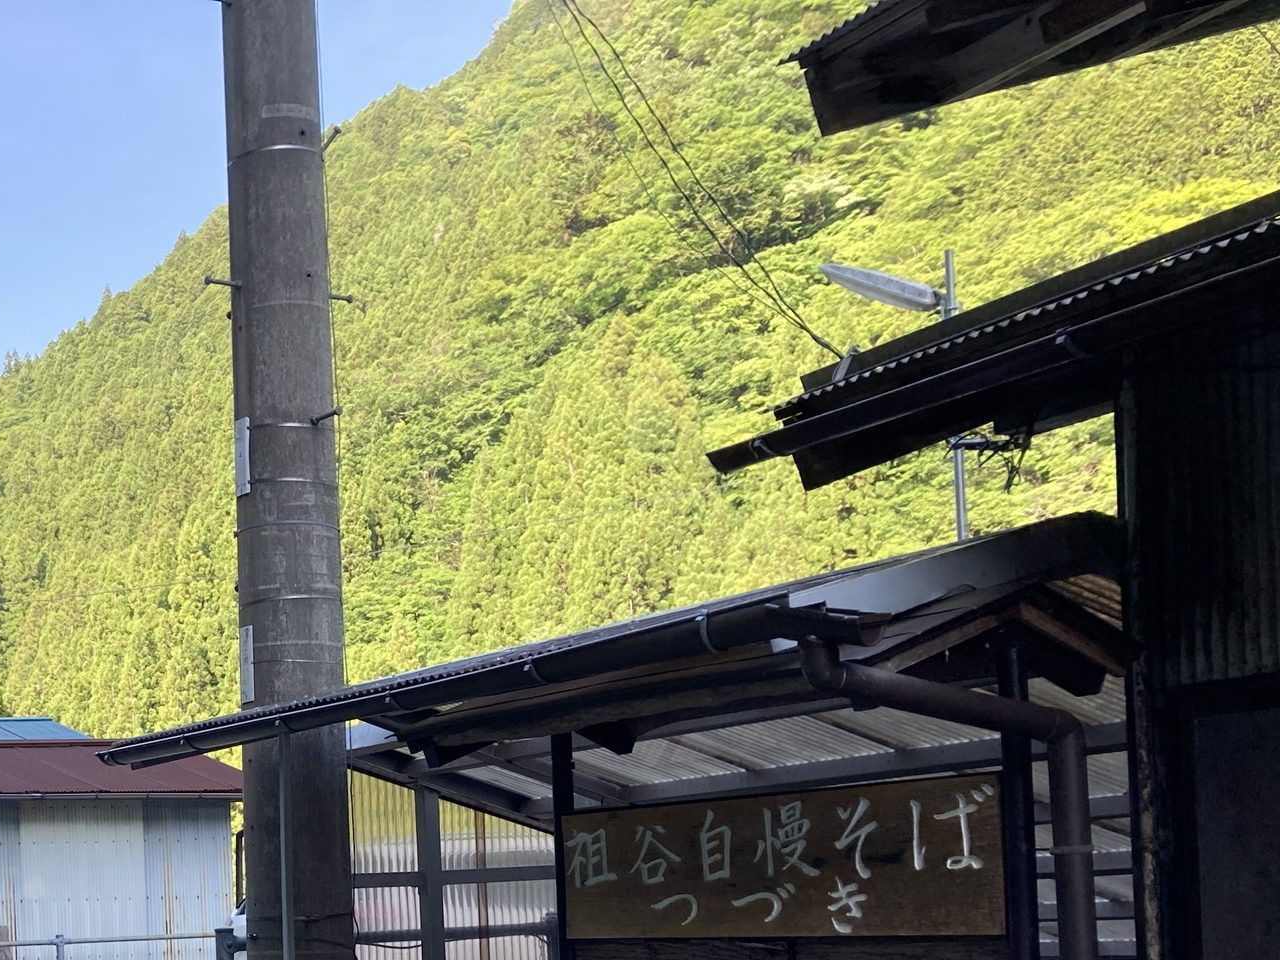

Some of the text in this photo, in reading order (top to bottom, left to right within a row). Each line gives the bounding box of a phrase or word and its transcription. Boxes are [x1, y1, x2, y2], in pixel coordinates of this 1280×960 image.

[566, 783, 996, 888] 祖谷自慢そば
[650, 876, 868, 934] つづき
